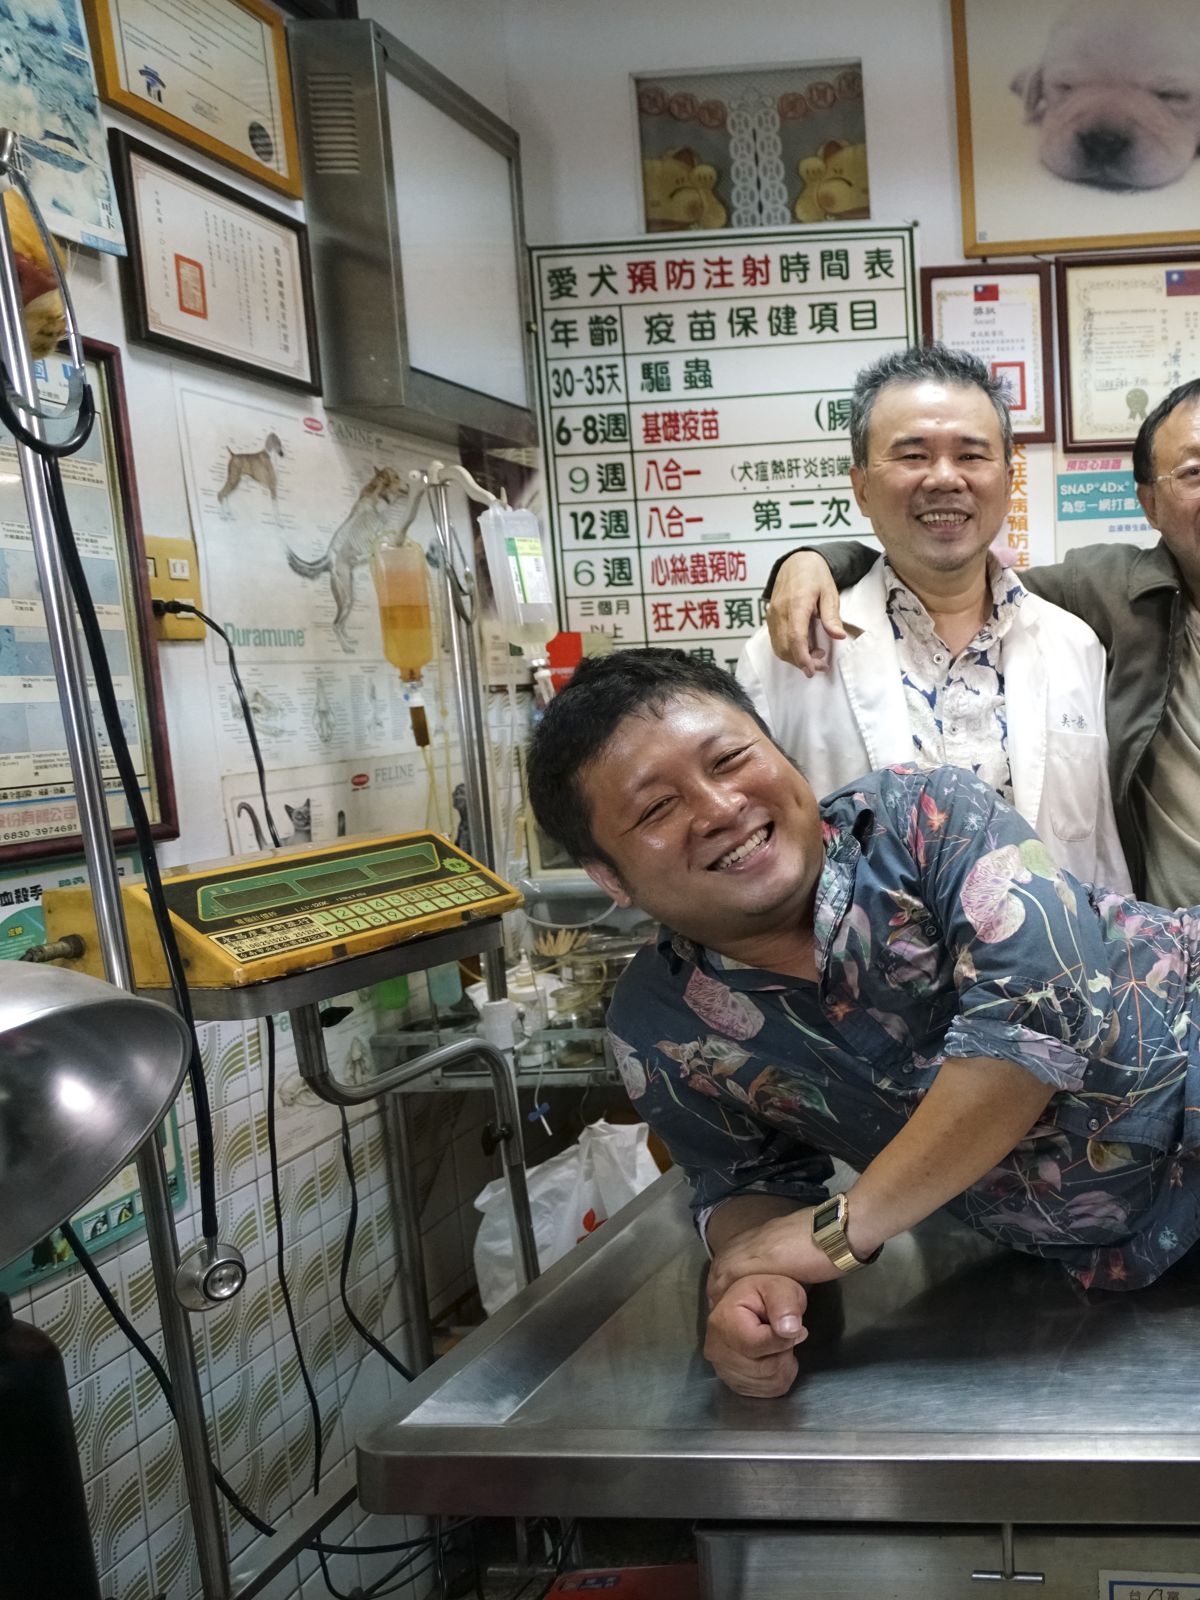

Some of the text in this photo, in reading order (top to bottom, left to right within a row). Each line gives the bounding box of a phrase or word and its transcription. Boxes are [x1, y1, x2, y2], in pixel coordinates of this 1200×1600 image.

[547, 248, 895, 300] 愛犬預防注射時間表
[550, 300, 878, 348] 年齡 疫苗保健項目
[551, 359, 714, 398] 30-35天 驅蟲
[556, 413, 627, 446] 6-8週
[642, 408, 719, 444] 基礎疫苗
[569, 462, 627, 496] 9週
[644, 458, 701, 493] 八合一
[570, 497, 852, 541] 12週 八合一 第二次
[573, 556, 634, 588] 6週
[651, 551, 747, 585] 心絲蟲預防
[580, 600, 630, 617] 三個月
[224, 622, 305, 647] Duramune
[375, 764, 415, 782] FELINE
[355, 905, 367, 913] 3
[391, 897, 402, 905] 5
[337, 909, 348, 918] 2
[370, 915, 382, 923] 8
[387, 911, 398, 919] 9
[334, 924, 346, 933] 6
[352, 919, 362, 928] 7
